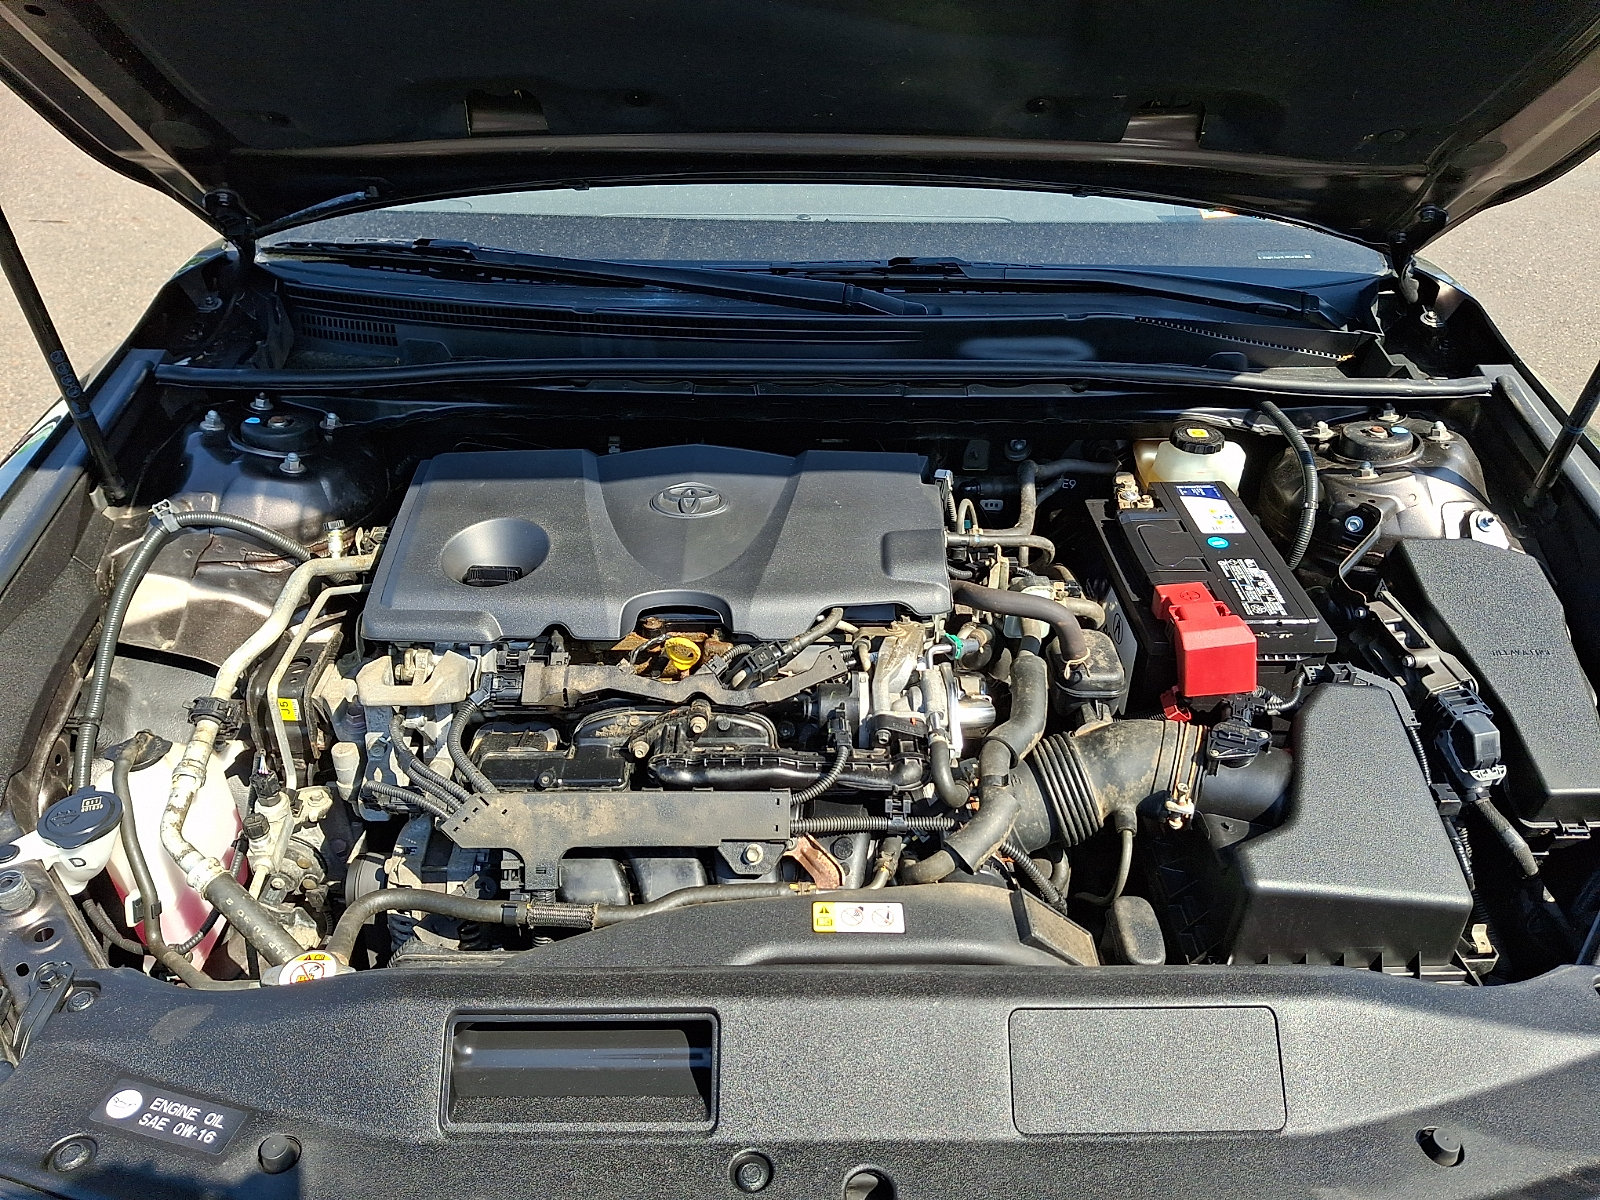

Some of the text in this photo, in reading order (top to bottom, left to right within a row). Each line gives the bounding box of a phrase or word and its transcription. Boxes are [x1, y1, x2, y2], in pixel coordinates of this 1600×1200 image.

[138, 1113, 217, 1144] SAE 0W-16
[149, 1097, 224, 1130] ENGINE OIL
